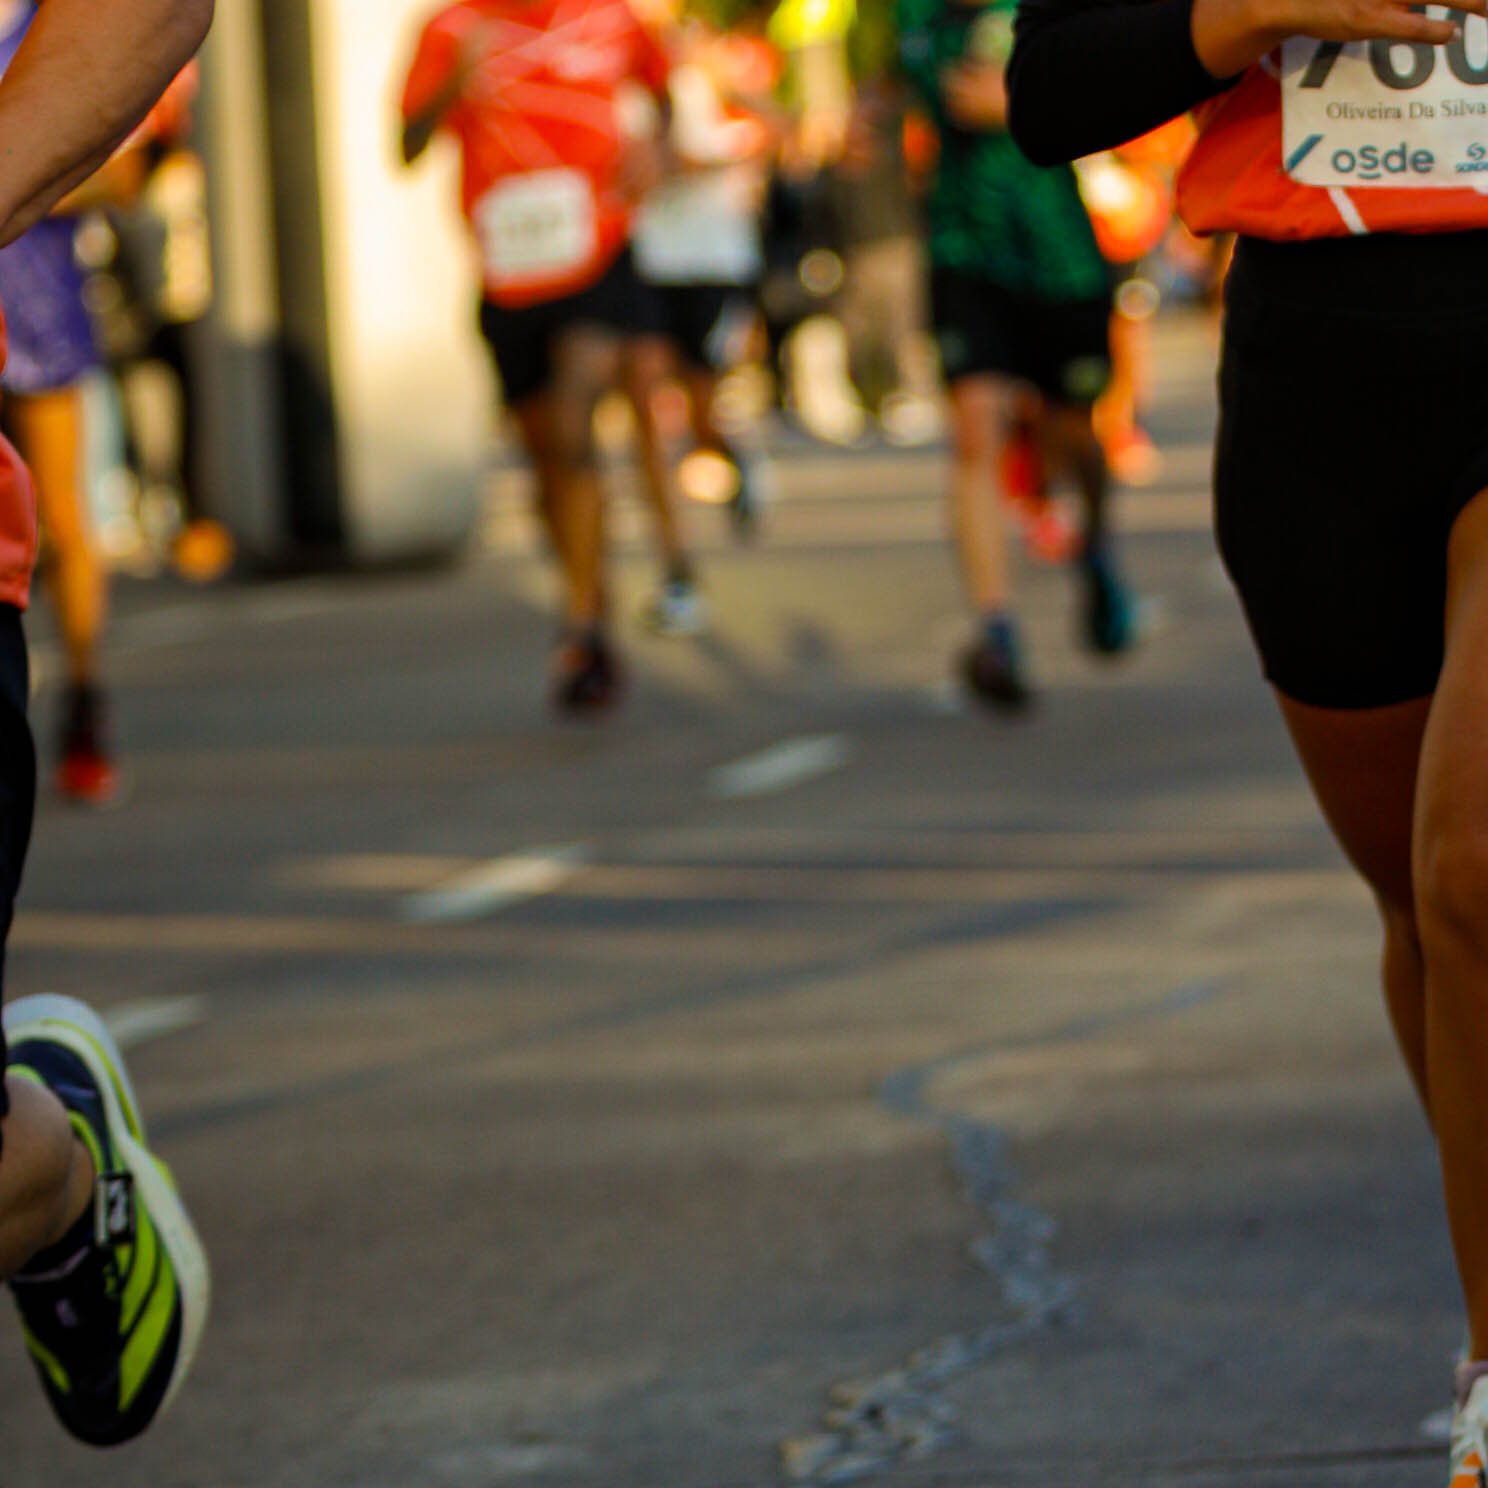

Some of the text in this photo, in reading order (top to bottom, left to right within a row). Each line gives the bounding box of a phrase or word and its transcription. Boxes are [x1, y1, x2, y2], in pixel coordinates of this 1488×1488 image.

[1326, 101, 1402, 120] Oliveira
[1409, 101, 1434, 119] Da
[1440, 98, 1487, 117] Silva
[1331, 142, 1435, 176] osde
